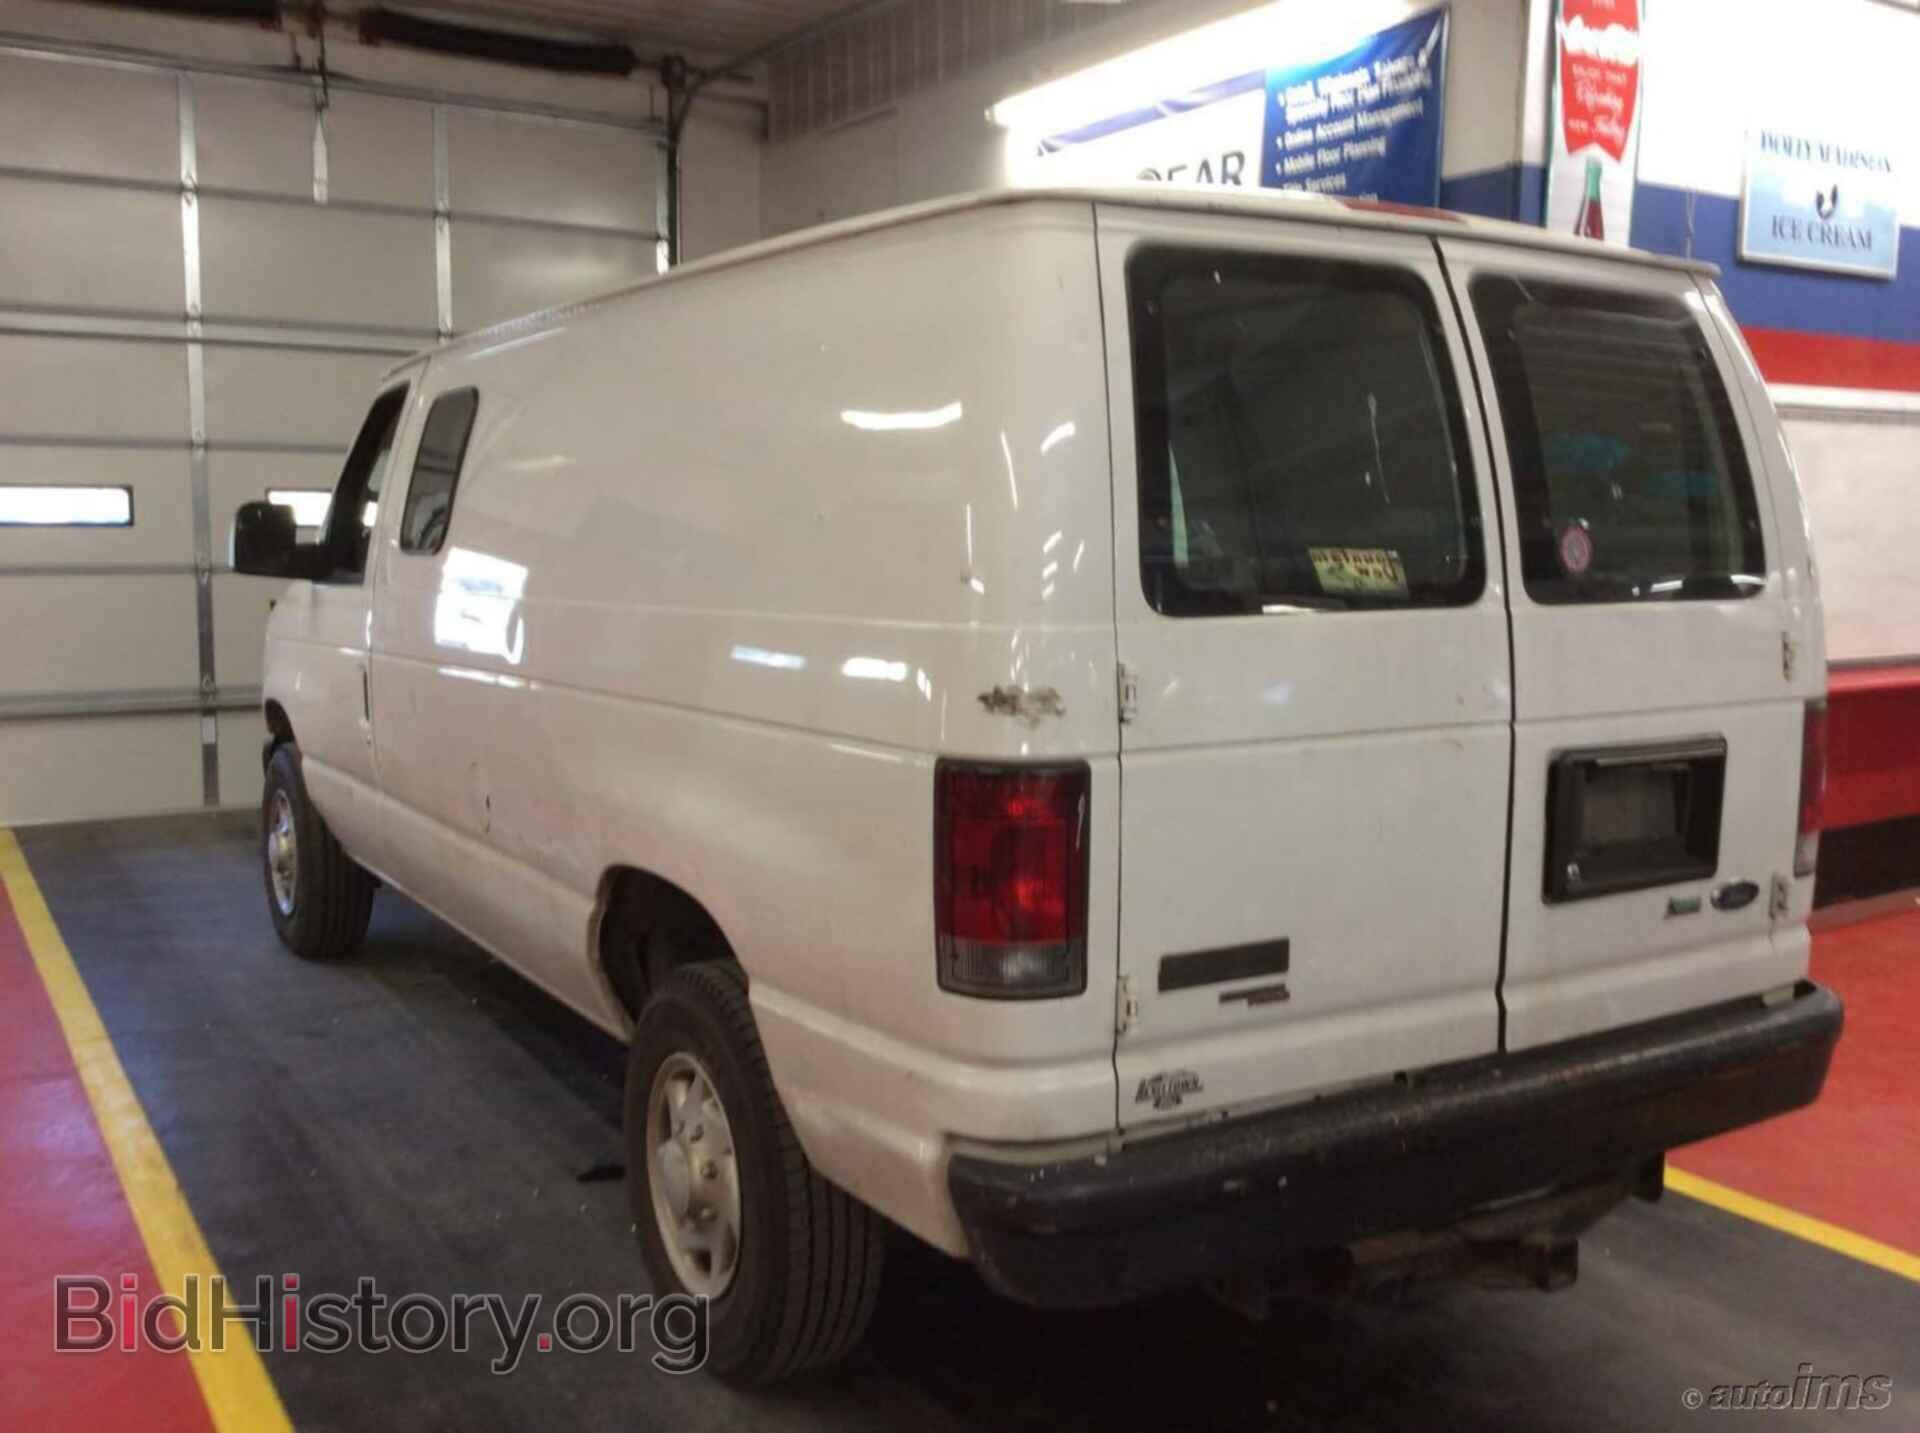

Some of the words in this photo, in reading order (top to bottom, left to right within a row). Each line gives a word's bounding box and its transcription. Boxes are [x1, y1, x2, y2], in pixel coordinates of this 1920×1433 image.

[1315, 115, 1355, 144] Account
[1357, 97, 1424, 132] Management
[1772, 214, 1803, 241] ICE
[1807, 220, 1872, 251] CREAM
